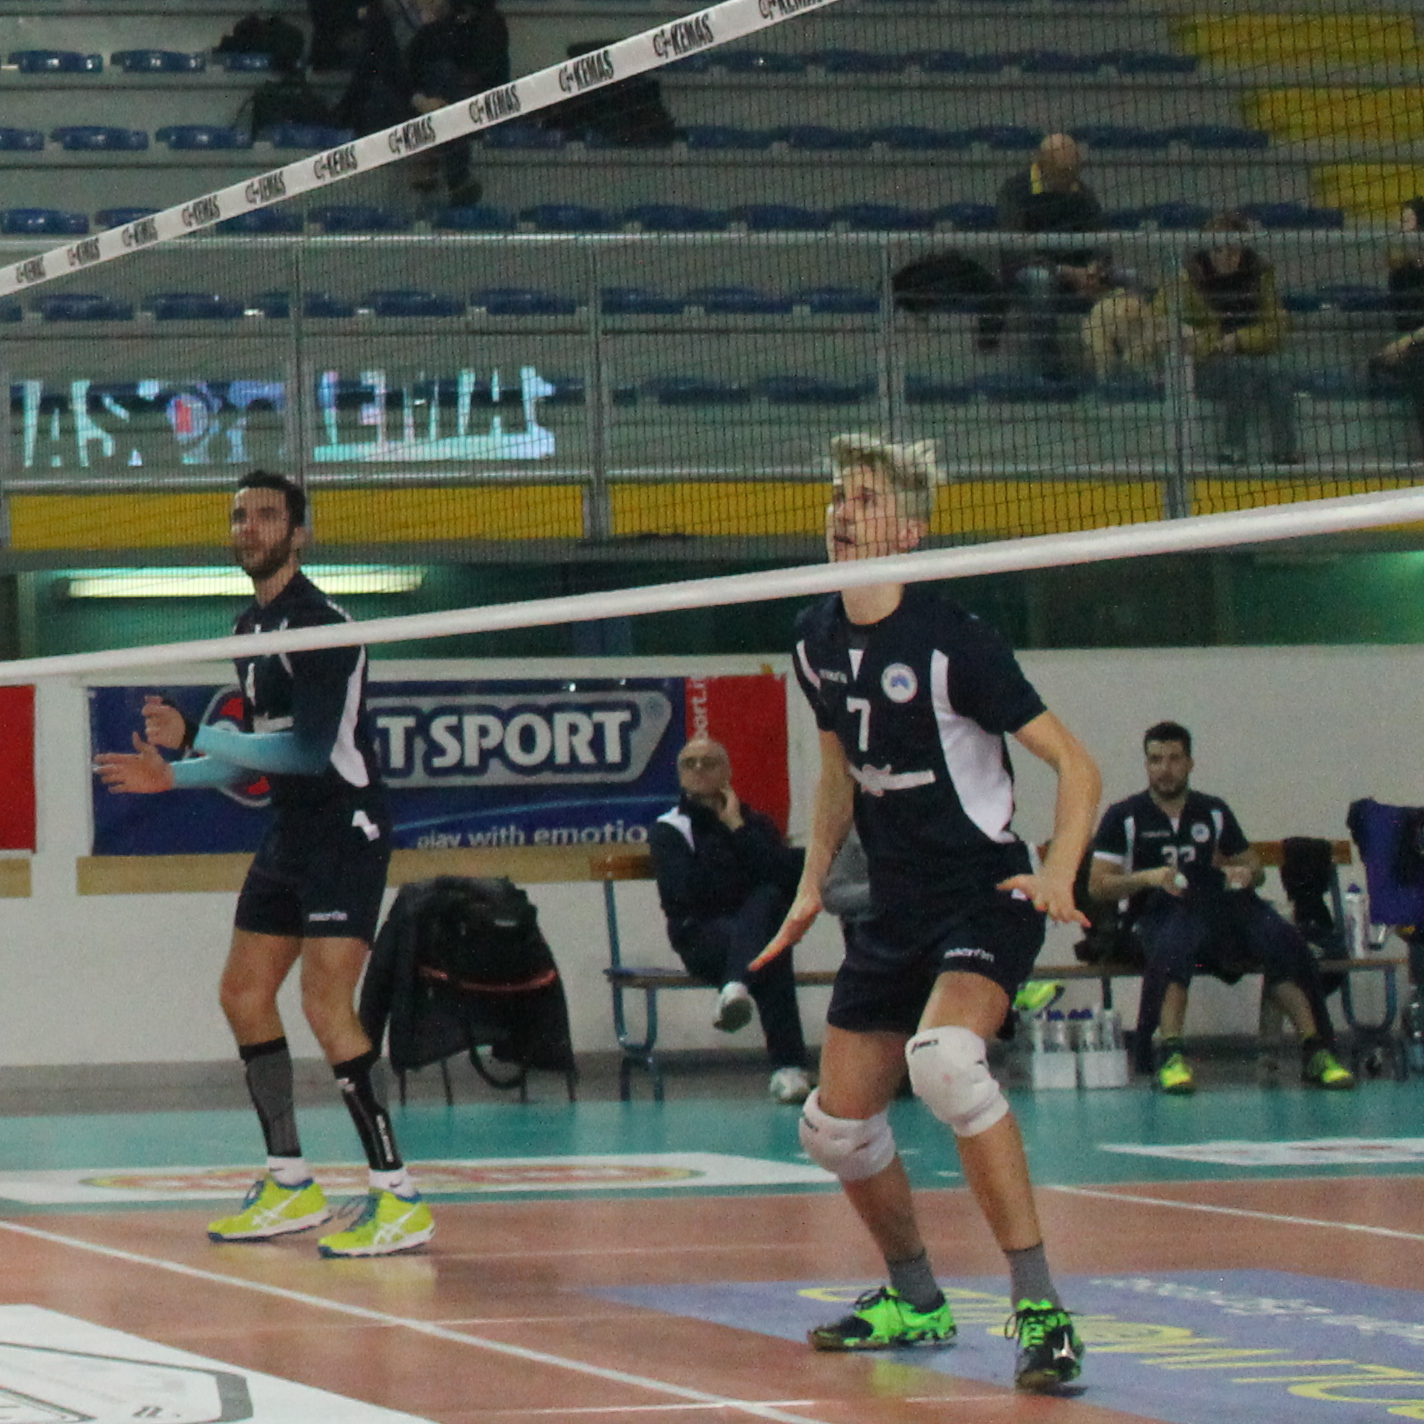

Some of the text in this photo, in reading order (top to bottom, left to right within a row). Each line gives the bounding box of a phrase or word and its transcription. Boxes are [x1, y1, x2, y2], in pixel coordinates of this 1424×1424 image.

[428, 710, 633, 768] SPORT
[845, 695, 872, 753] 7
[468, 824, 526, 847] with
[534, 818, 649, 846] emotio
